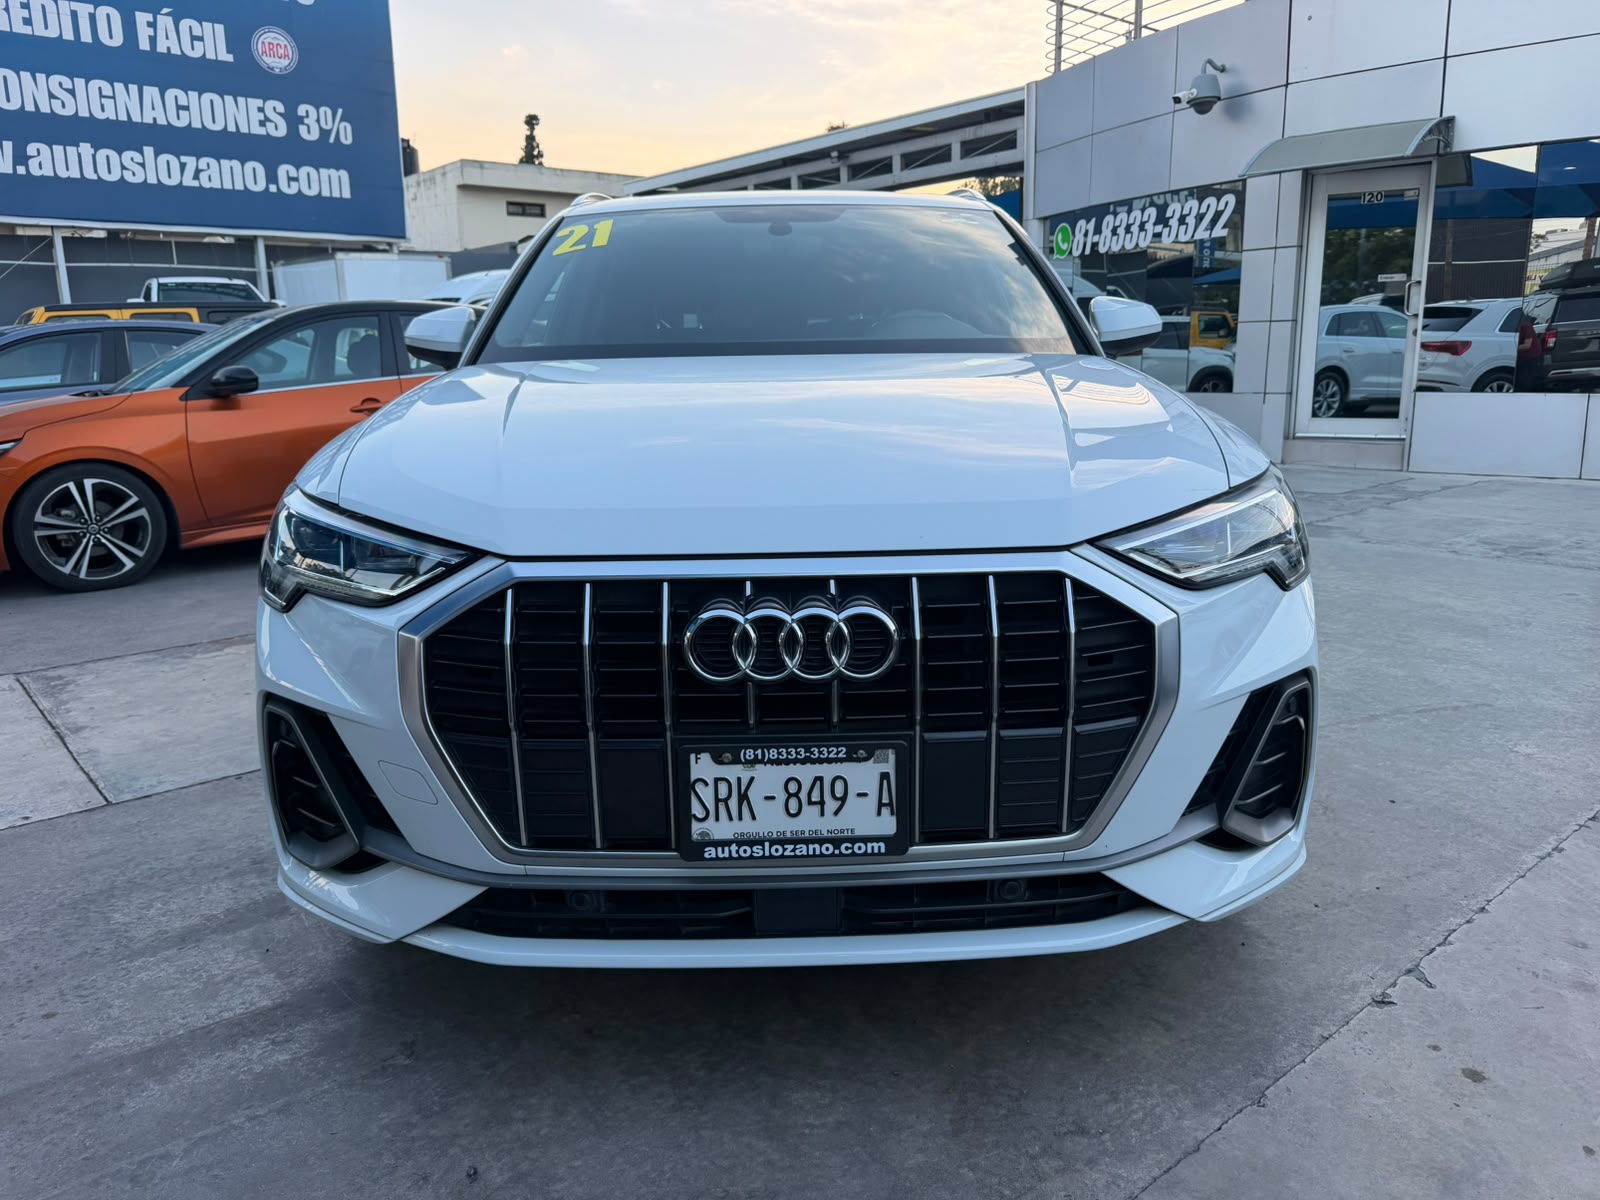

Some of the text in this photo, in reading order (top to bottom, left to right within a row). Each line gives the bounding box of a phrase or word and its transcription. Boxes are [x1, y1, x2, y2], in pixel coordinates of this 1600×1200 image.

[134, 8, 234, 62] FÁCIL
[261, 41, 290, 60] ARCA
[298, 104, 353, 145] 3%
[1361, 192, 1383, 204] 120
[552, 219, 614, 256] 21
[1071, 193, 1237, 257] 81-8333-3322
[740, 747, 847, 762] (81)8333-3322
[690, 771, 896, 822] SRK-849-A
[733, 831, 774, 839] ORGULLO
[776, 830, 787, 838] DE
[808, 829, 824, 837] DEL
[827, 828, 856, 836] NORTE
[703, 841, 886, 859] autoslozano.com
